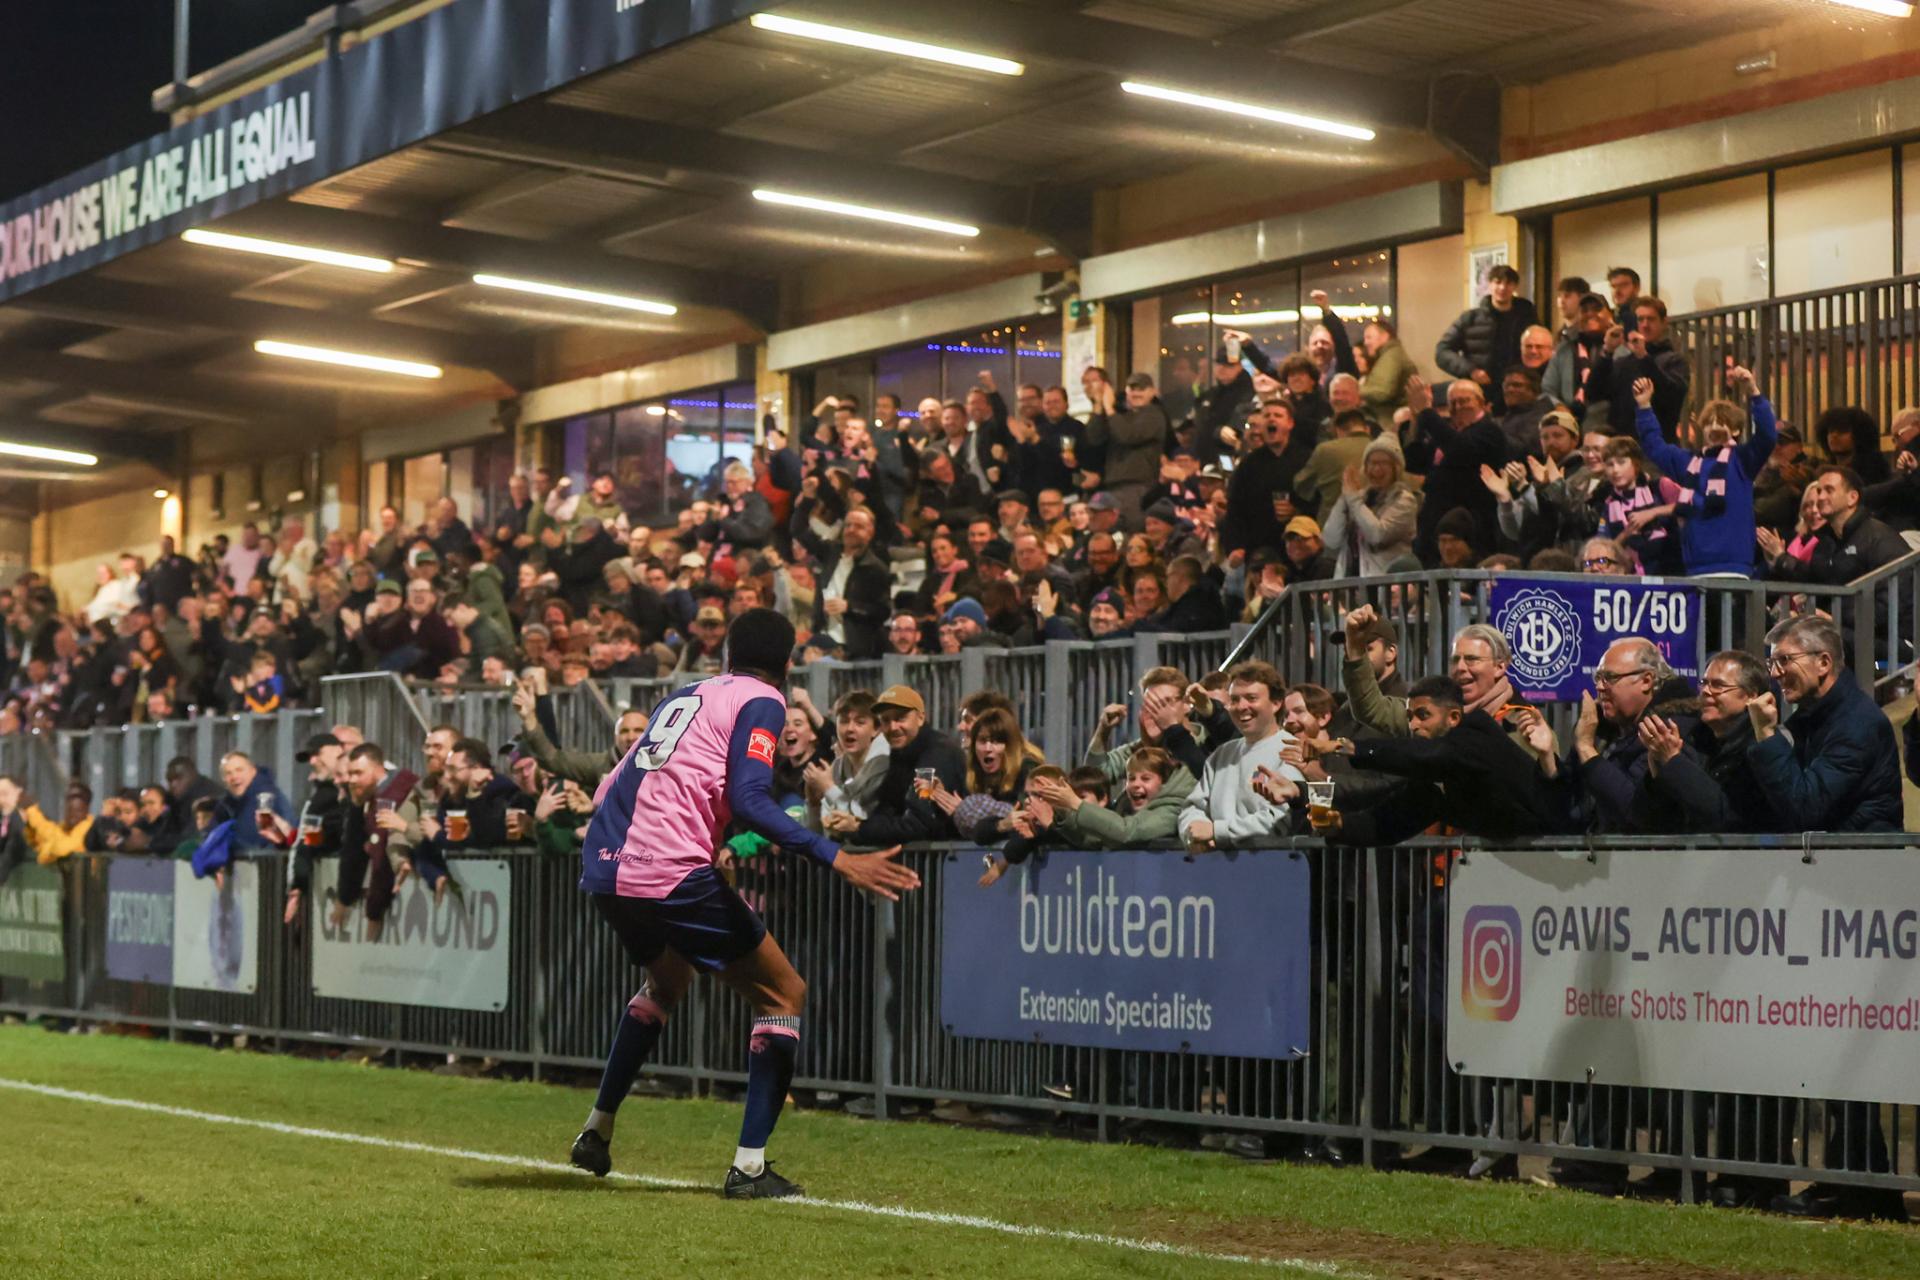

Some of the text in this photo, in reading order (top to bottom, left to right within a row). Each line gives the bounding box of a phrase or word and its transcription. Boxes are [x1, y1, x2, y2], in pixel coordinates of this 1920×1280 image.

[33, 182, 101, 268] HOUSE
[101, 165, 138, 240] WE
[137, 145, 184, 226] ARE
[184, 128, 228, 208] ALL
[229, 91, 316, 190] EQUAL
[1505, 600, 1532, 640] DULWICH
[1534, 600, 1568, 622] HAMLET
[1593, 589, 1687, 634] 50/50
[1512, 654, 1550, 677] FOUNDED
[634, 695, 703, 771] 9
[1020, 865, 1215, 960] buildteam
[1020, 987, 1212, 1034] Extension Specialists
[1565, 987, 1625, 1019] Better
[1631, 988, 1687, 1022] Shots
[1693, 991, 1750, 1025] Than
